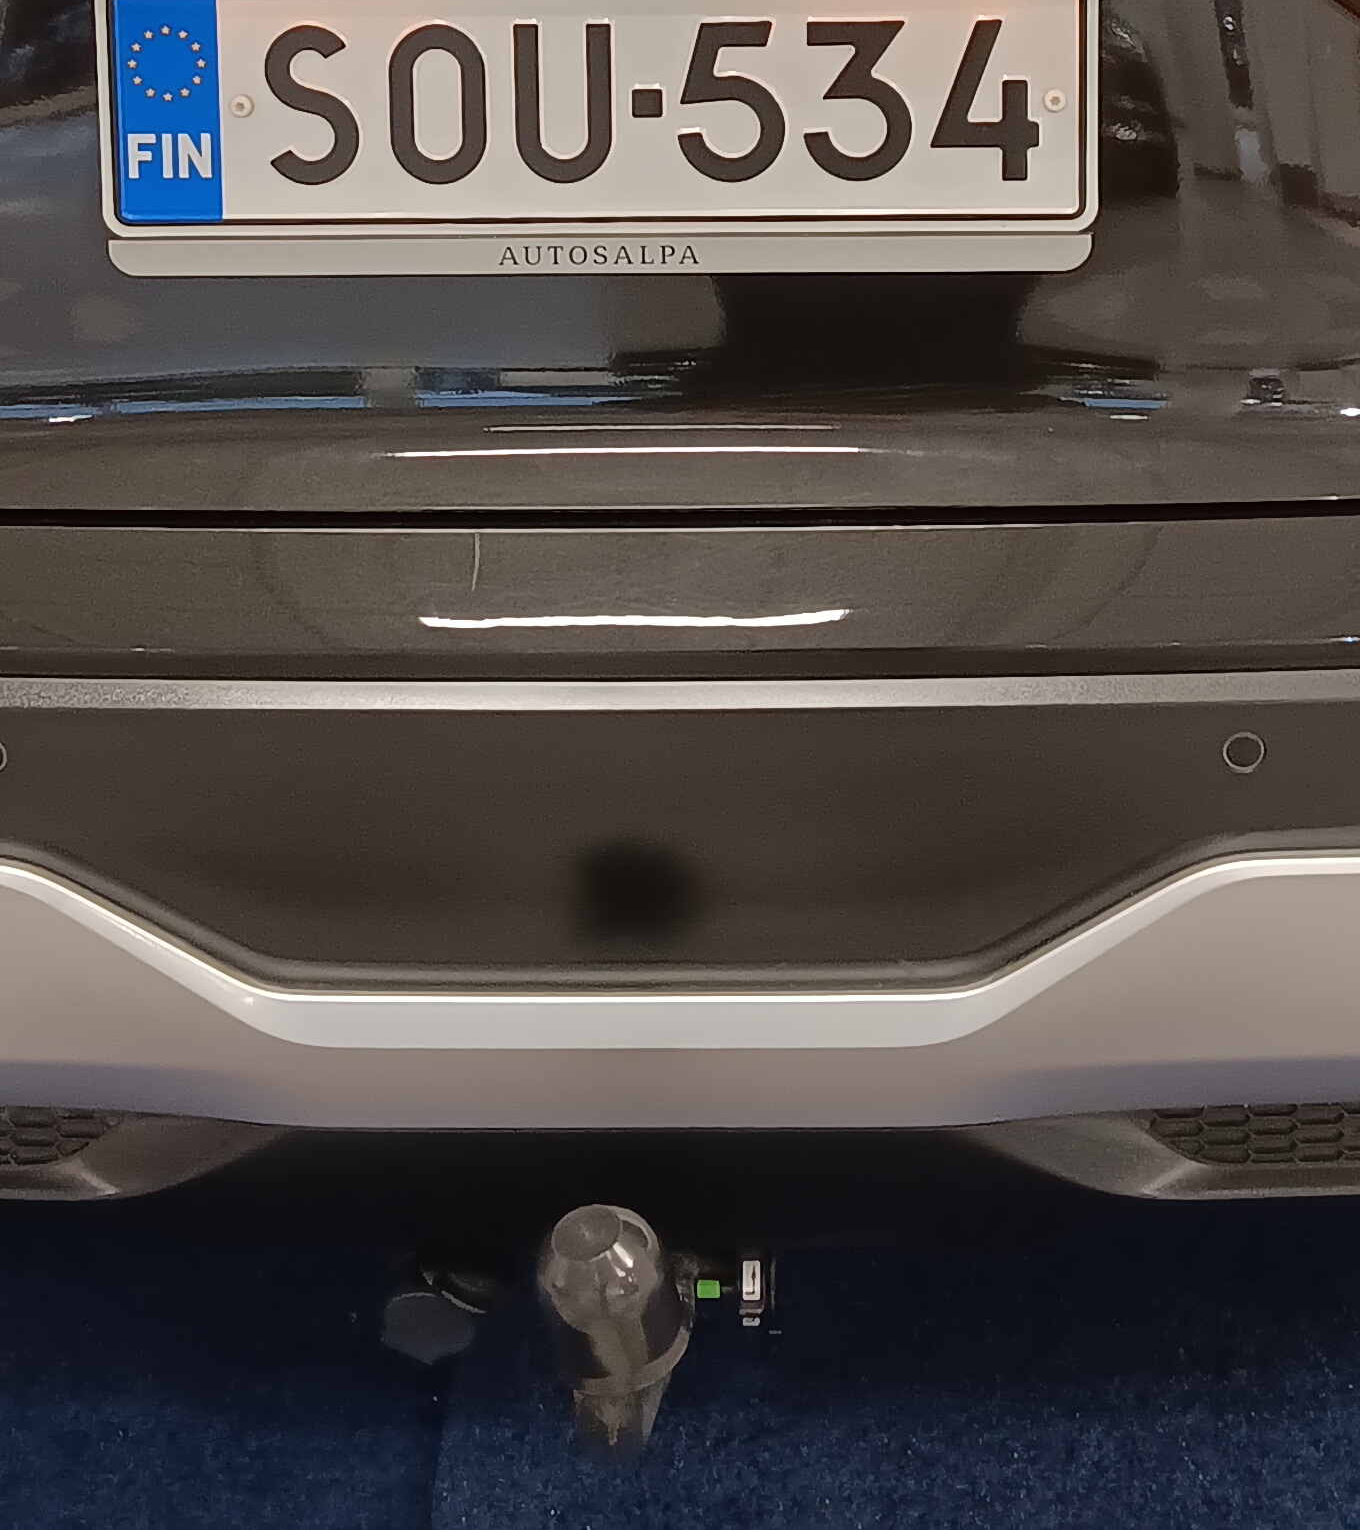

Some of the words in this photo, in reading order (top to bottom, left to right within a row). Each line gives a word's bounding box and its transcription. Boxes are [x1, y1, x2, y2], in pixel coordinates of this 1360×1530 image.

[263, 19, 1040, 185] SOU-534
[127, 133, 214, 180] FIN
[498, 244, 701, 267] AUTOSALPA
